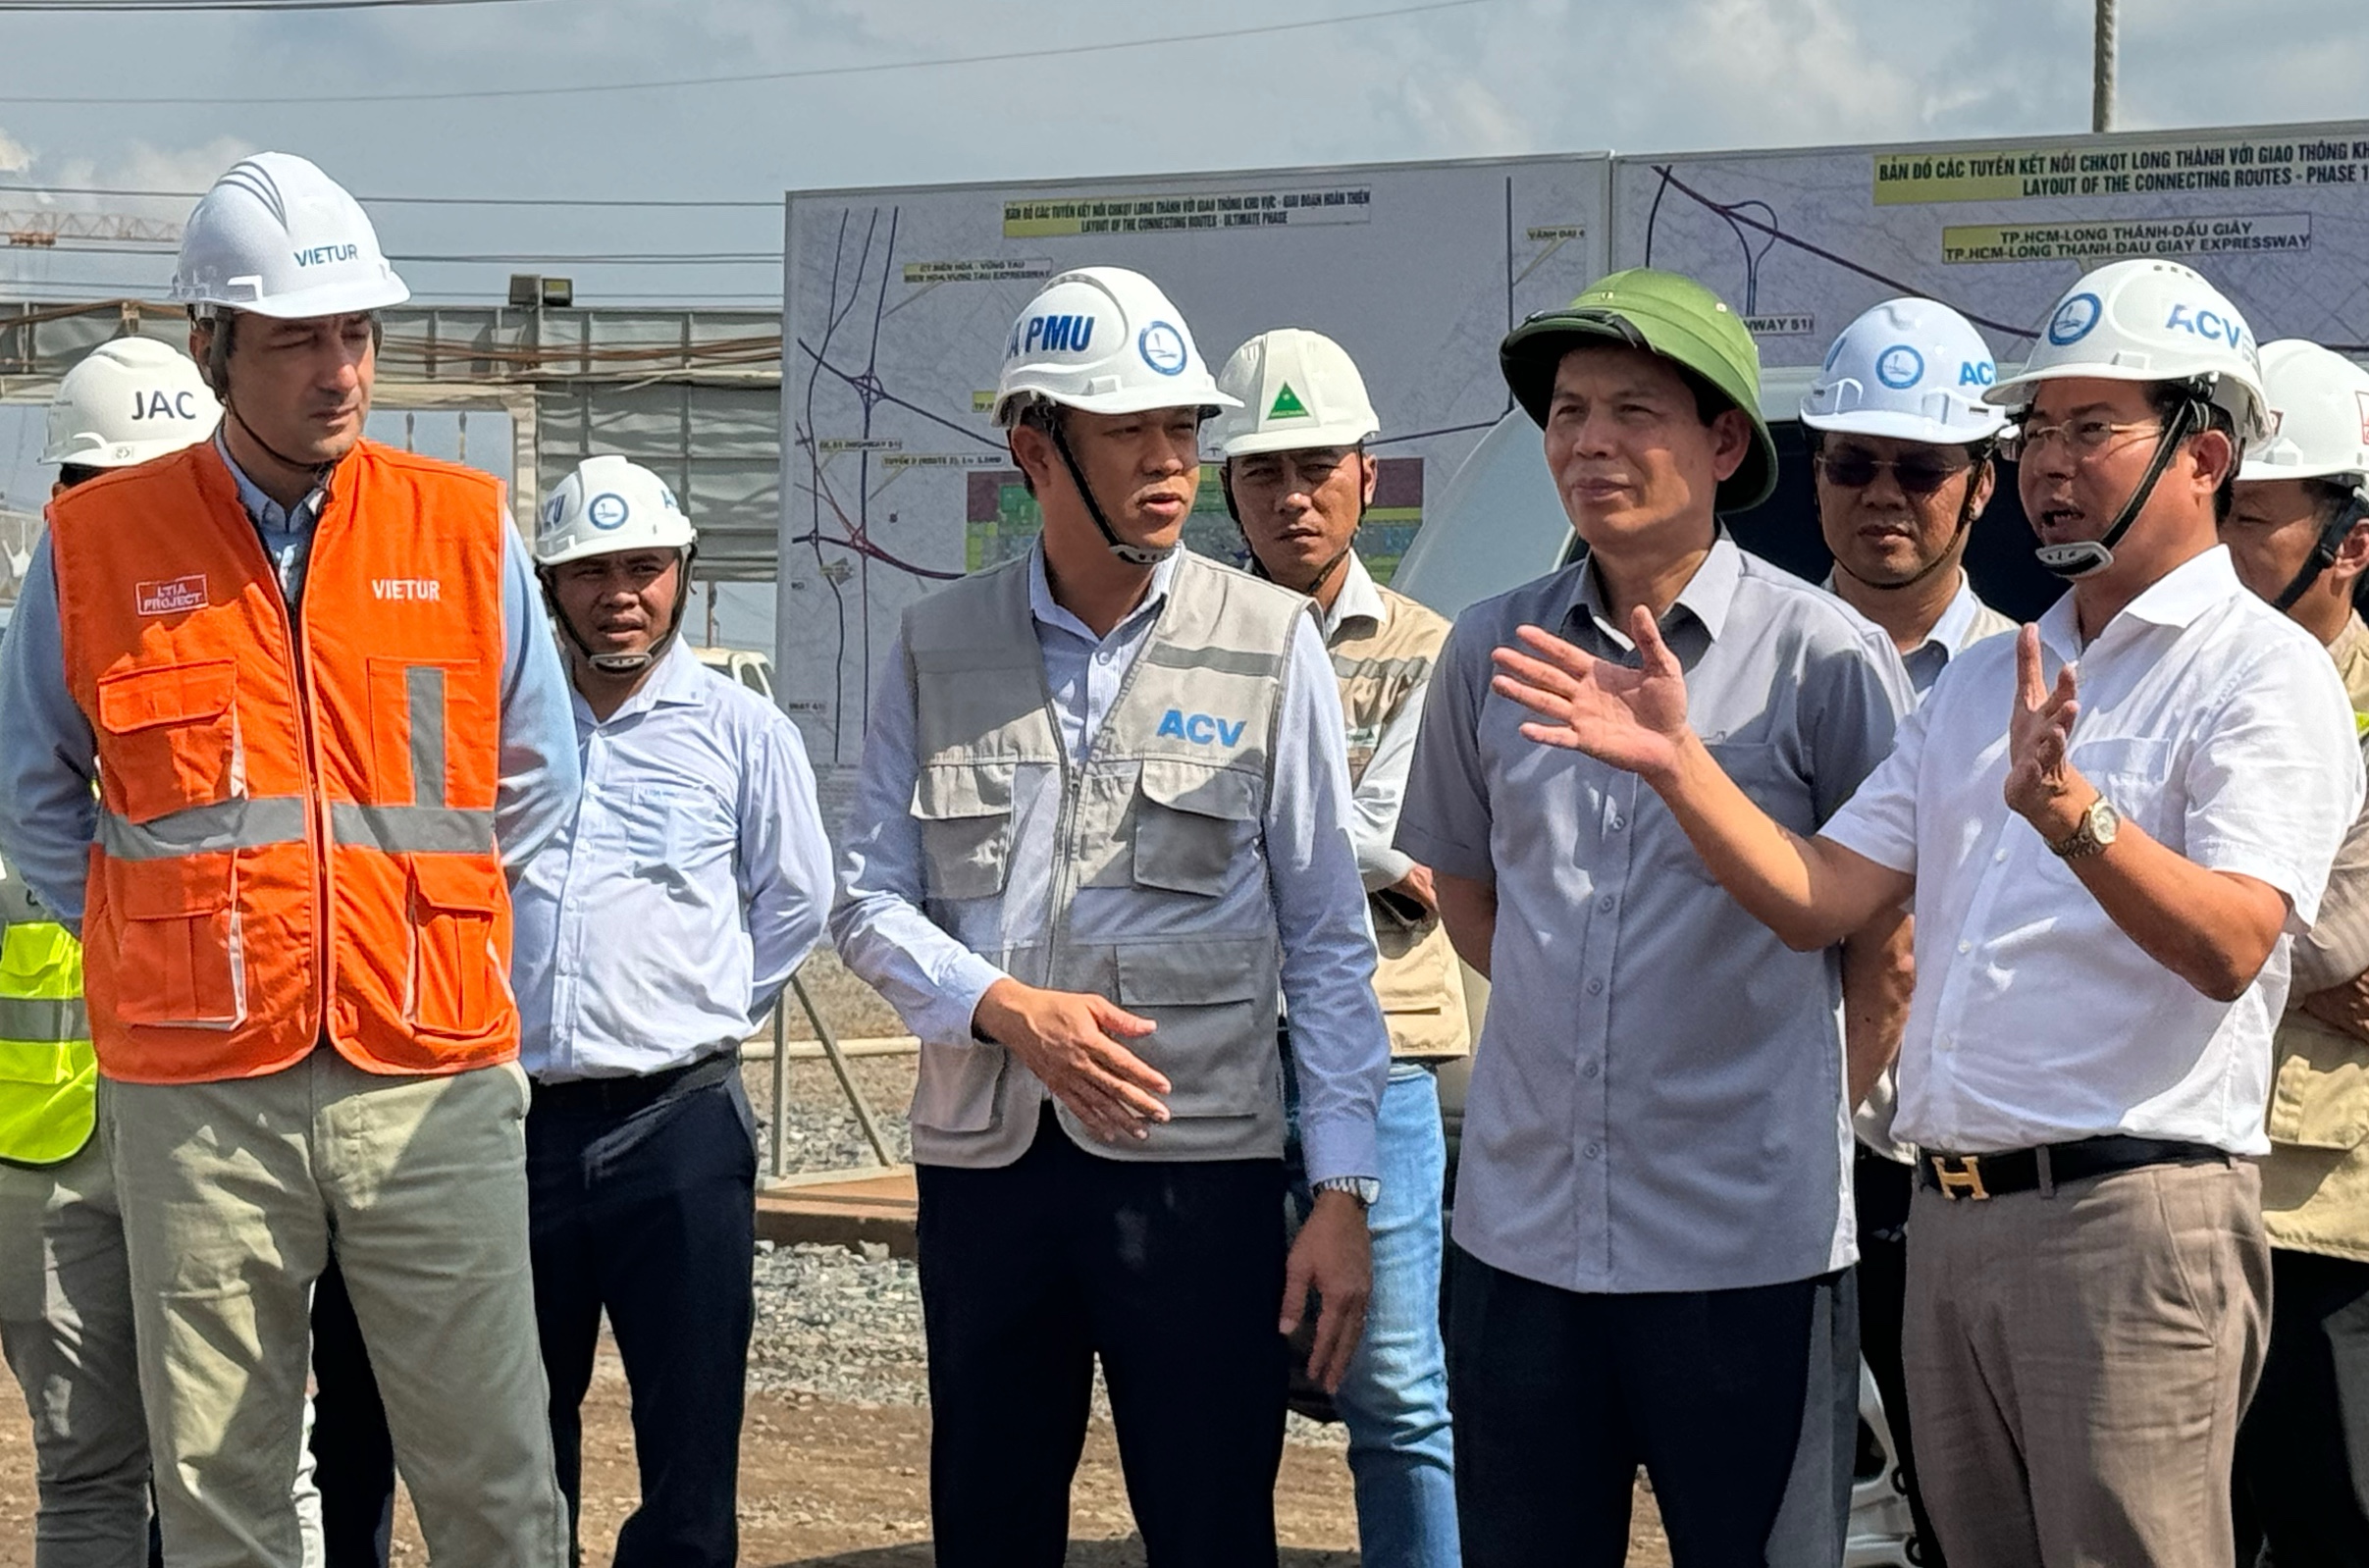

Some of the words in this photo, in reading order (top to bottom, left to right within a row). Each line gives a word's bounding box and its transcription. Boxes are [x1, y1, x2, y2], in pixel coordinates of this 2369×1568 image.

[1879, 155, 1909, 182] BẢN
[1936, 157, 1966, 180] CÁC
[2019, 150, 2046, 175] KẾT
[2050, 148, 2076, 174] NỐI
[2079, 152, 2128, 173] CHKQT
[2132, 150, 2171, 171] LONG
[2259, 144, 2293, 164] GIAO
[2298, 139, 2347, 162] THÔNG
[2023, 178, 2078, 196] LAYOUT
[2081, 176, 2099, 194] OF
[2103, 174, 2130, 193] THE
[2134, 170, 2231, 192] CONNECTING
[2235, 166, 2292, 187] ROUTES
[2306, 163, 2357, 183] PHASE
[2361, 163, 2368, 183] 1
[1138, 216, 1186, 231] CONNECTING
[1187, 214, 1217, 229] ROUTES
[1224, 213, 1260, 227] ULTIMATE
[1262, 210, 1288, 226] PHASE
[293, 243, 359, 267] VIETUR
[2156, 238, 2195, 253] GIAY
[2200, 234, 2310, 251] EXPRESSWAY
[1025, 315, 1095, 353] PMU
[2165, 303, 2241, 349] ACV
[132, 391, 196, 420] JAC
[143, 592, 202, 611] PROJECT
[371, 578, 441, 602] VIETUR
[1157, 709, 1247, 748] ACV
